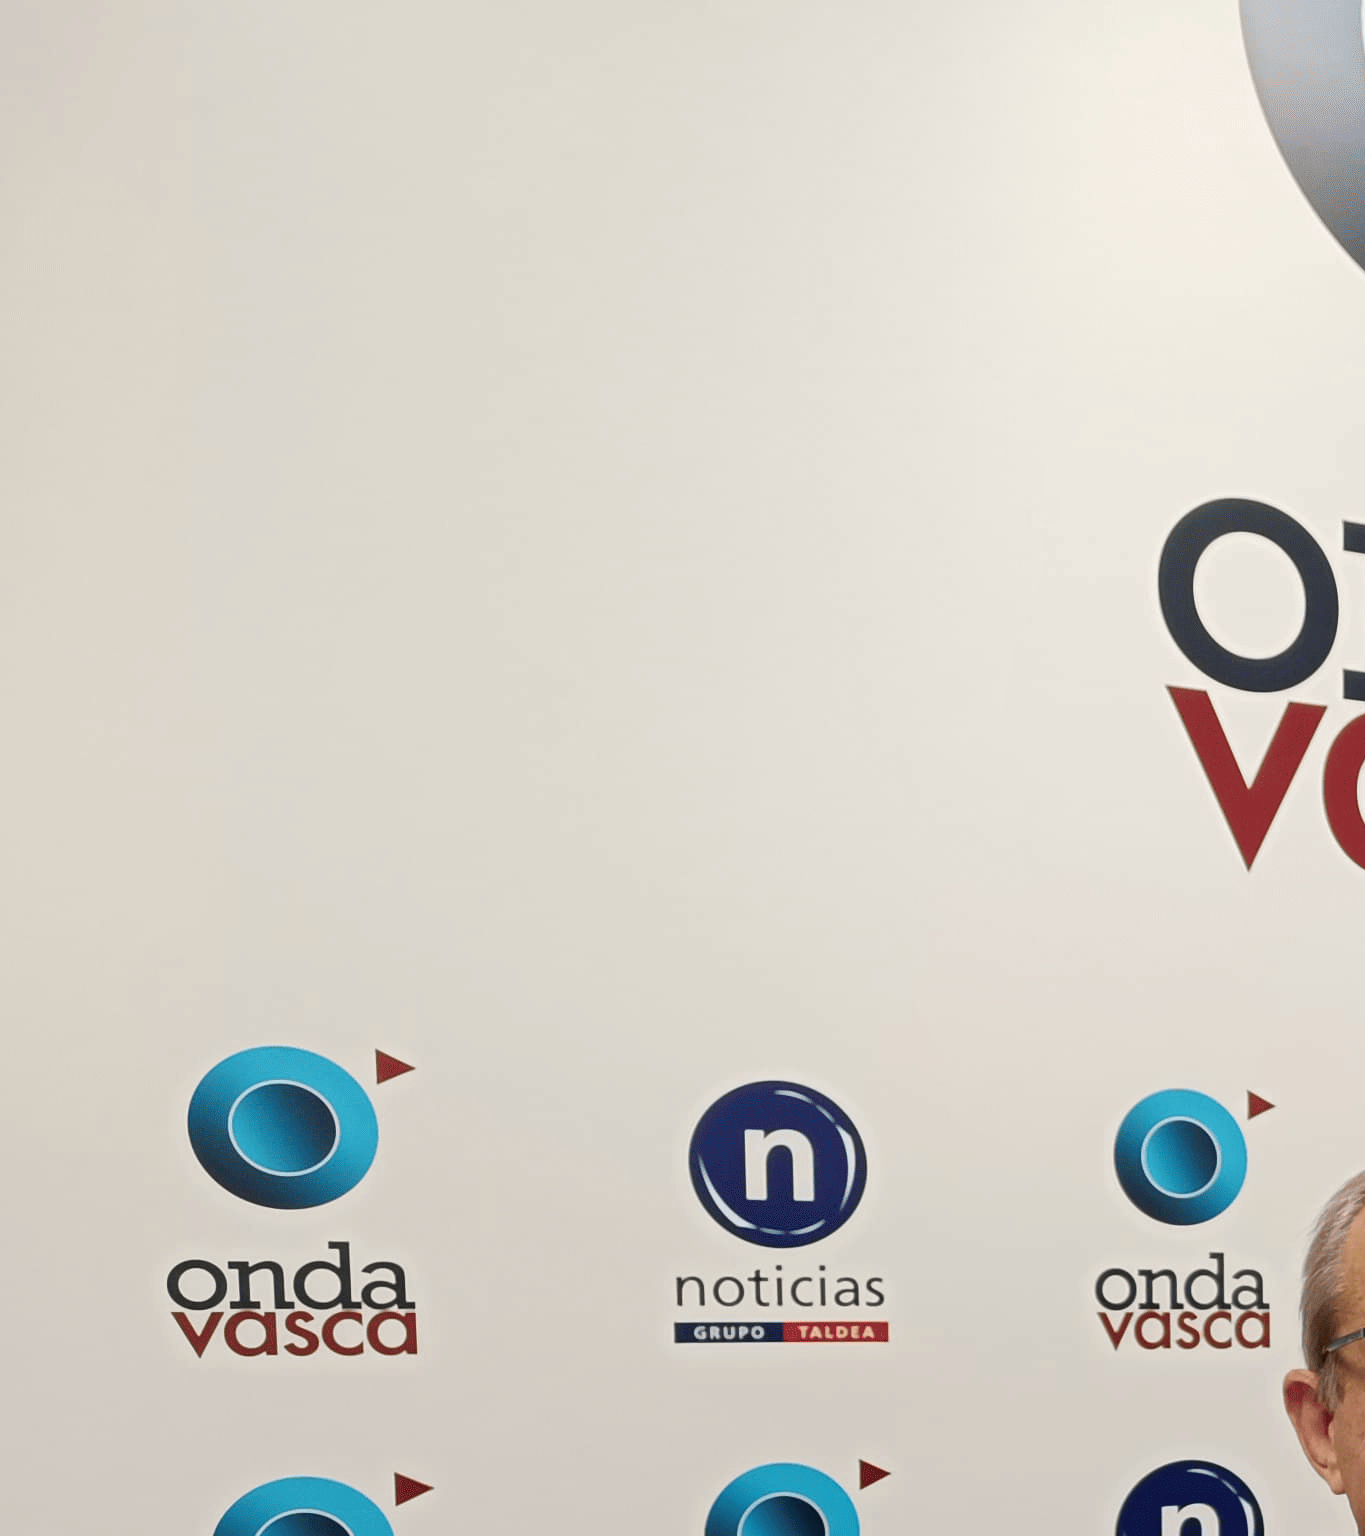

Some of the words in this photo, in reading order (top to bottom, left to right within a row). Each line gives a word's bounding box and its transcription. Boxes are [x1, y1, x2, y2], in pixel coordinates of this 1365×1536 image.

[166, 1241, 416, 1311] onda
[674, 1264, 886, 1308] noticias
[1095, 1253, 1271, 1311] onda
[171, 1309, 419, 1358] vasca
[693, 1325, 766, 1340] GRUPO
[797, 1325, 876, 1340] TALDEA
[1097, 1309, 1271, 1350] vasca
